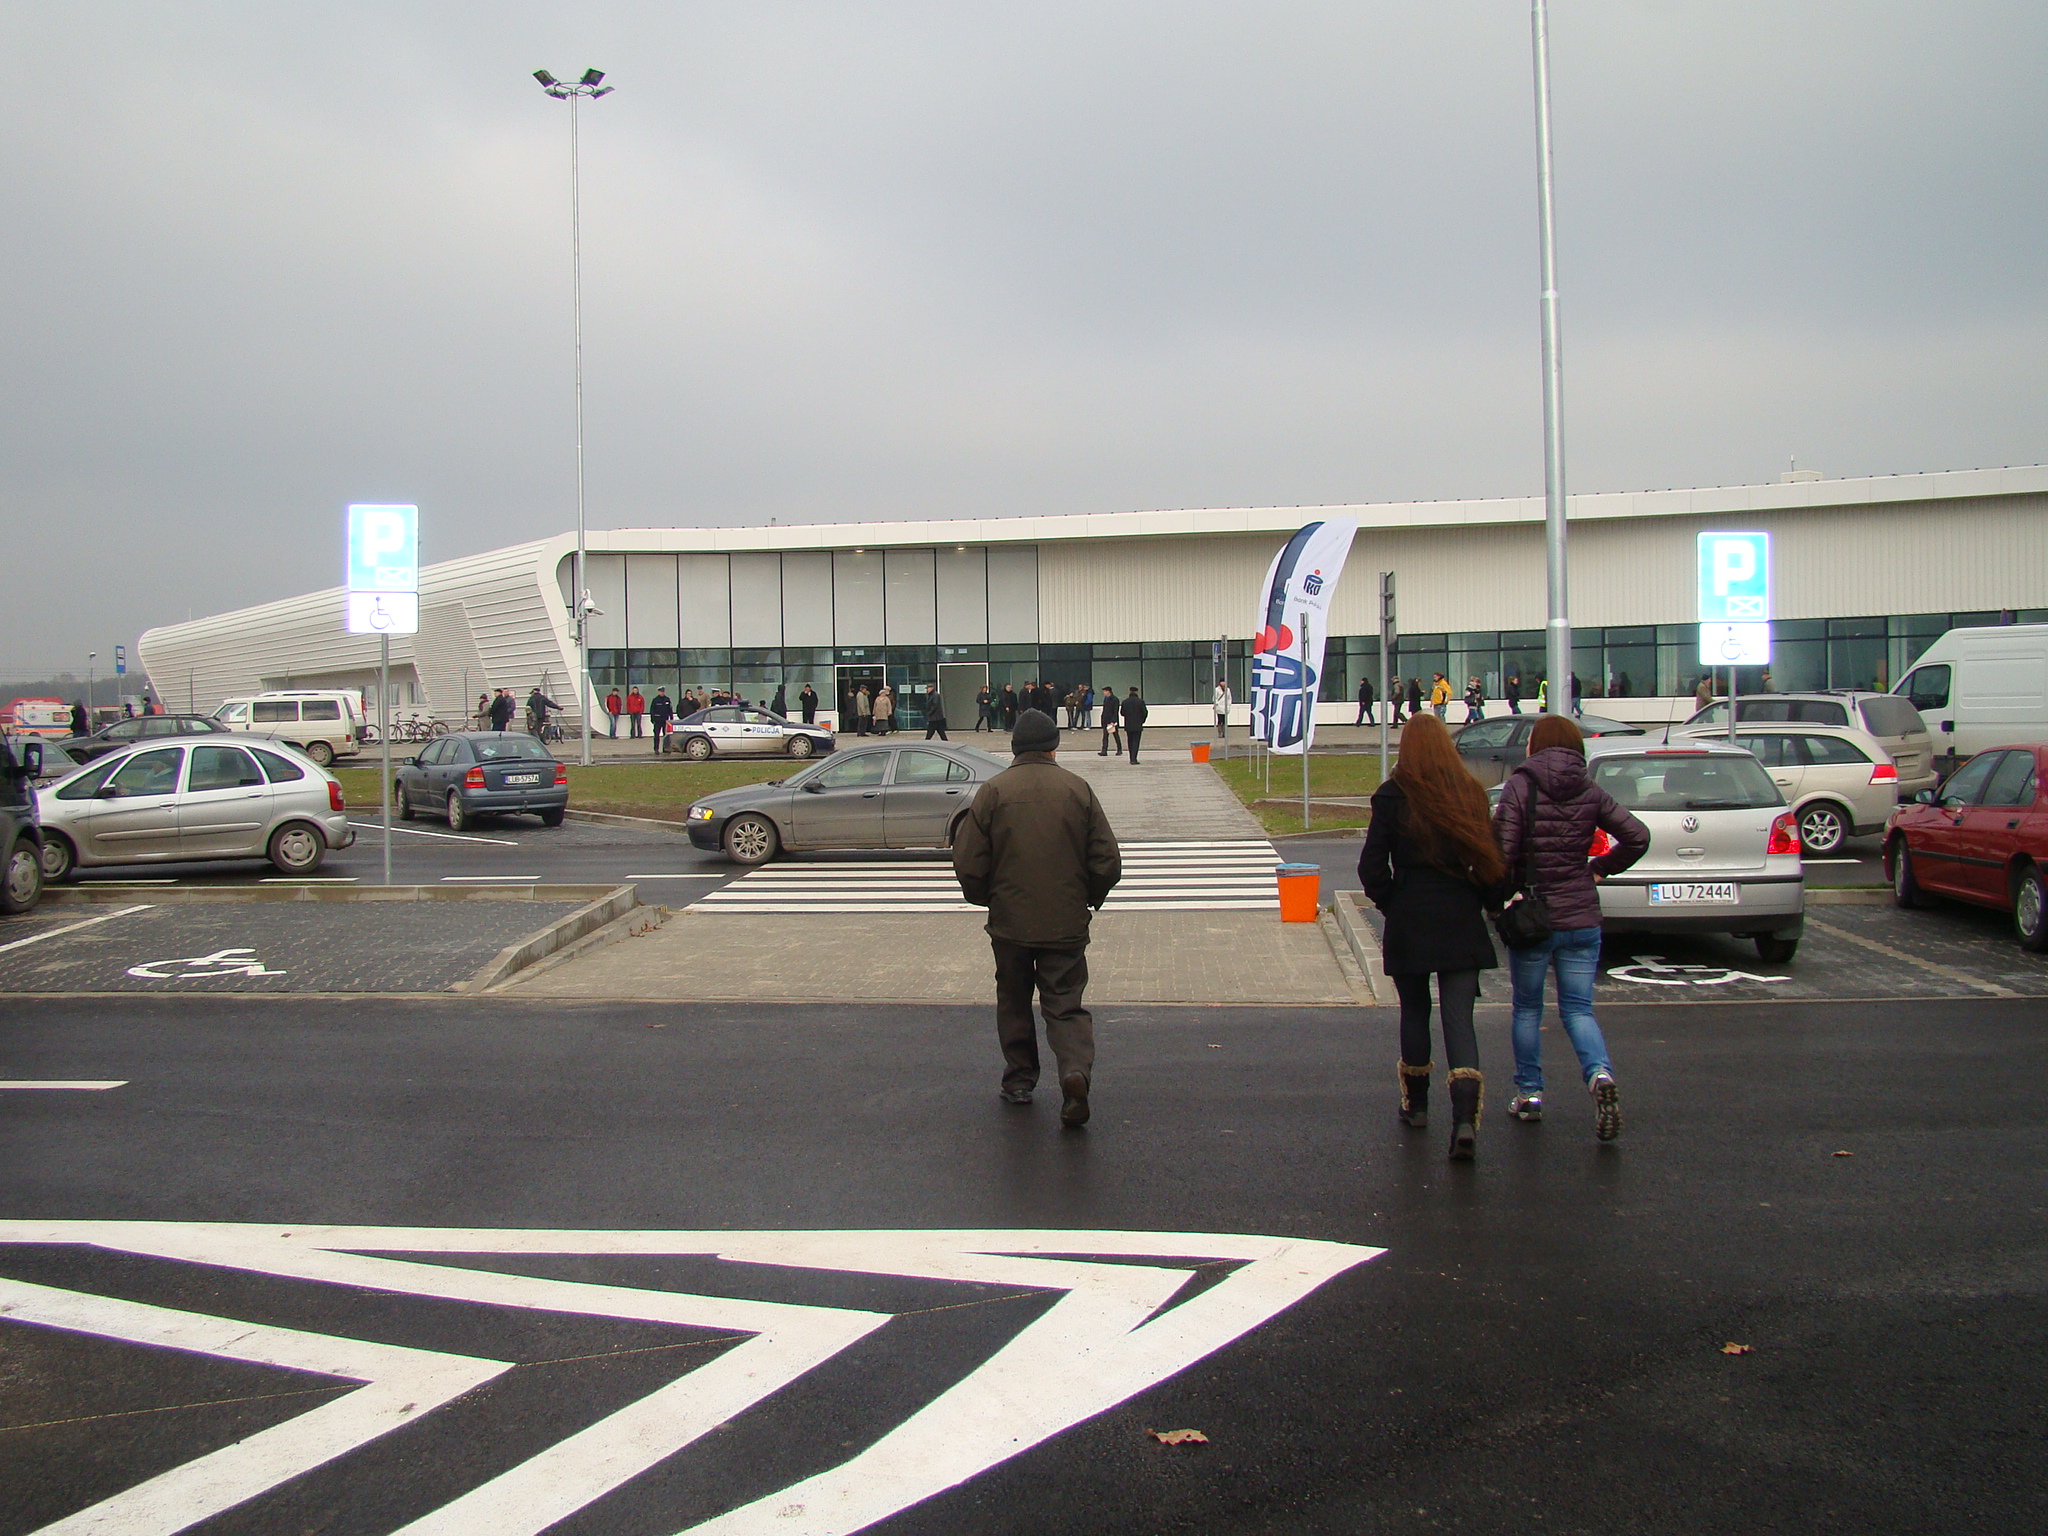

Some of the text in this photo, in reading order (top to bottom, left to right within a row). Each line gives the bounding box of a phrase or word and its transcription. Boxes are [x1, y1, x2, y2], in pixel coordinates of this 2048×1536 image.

[363, 512, 405, 567] P
[1713, 540, 1755, 596] P
[1303, 574, 1324, 596] PKO
[1294, 596, 1307, 605] Bank
[752, 726, 781, 734] POLICJA
[1662, 884, 1732, 899] LU 72444
